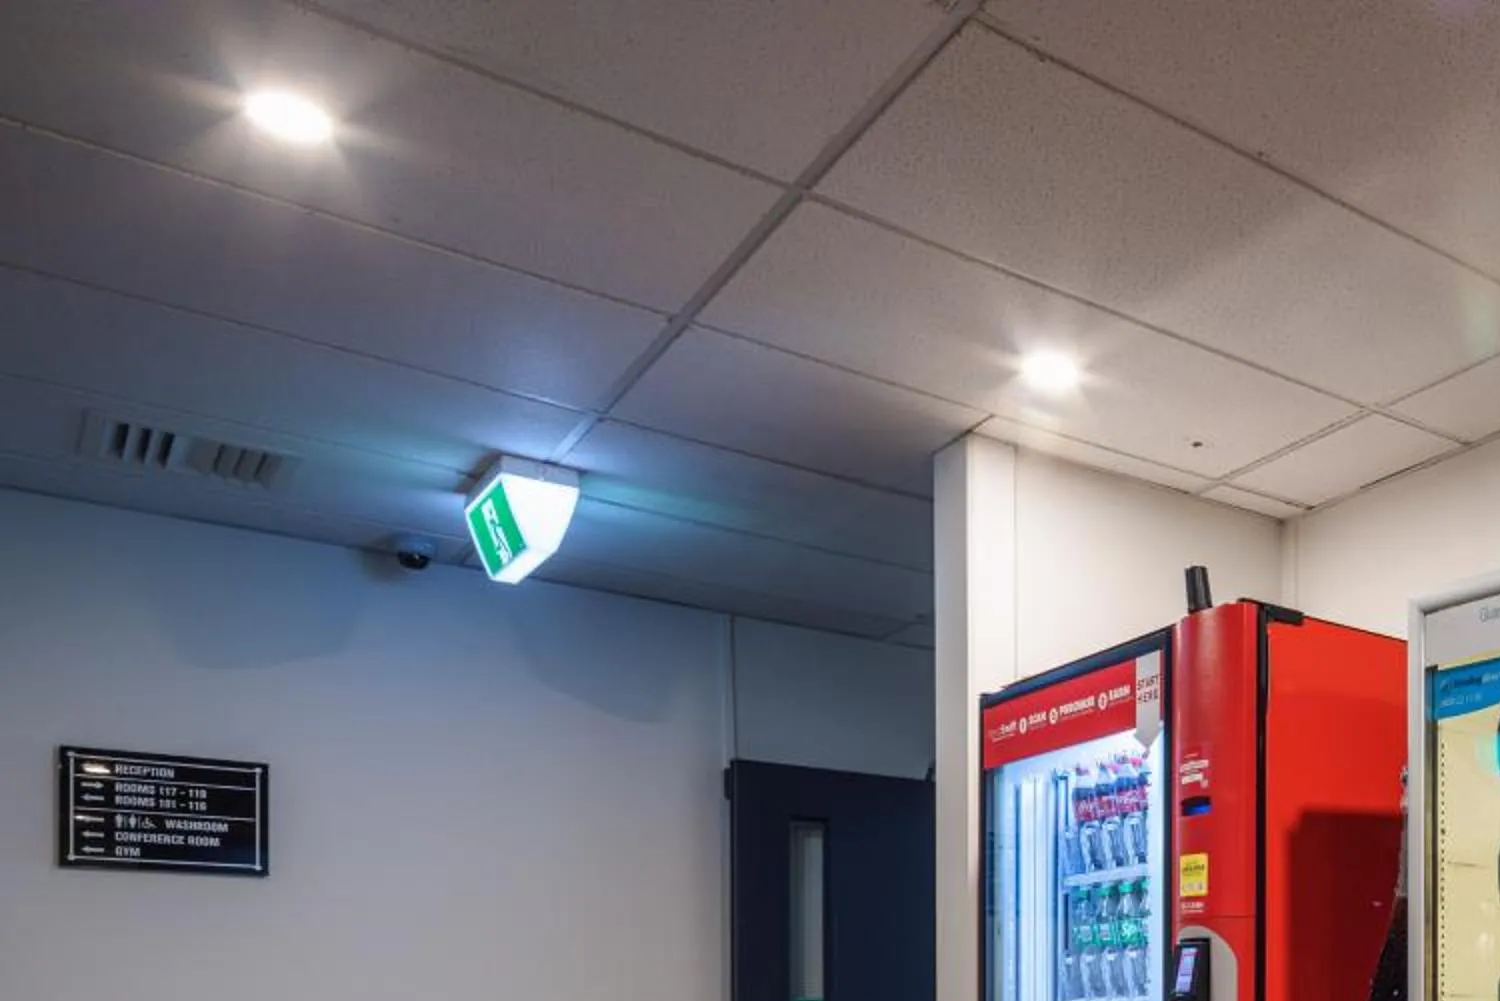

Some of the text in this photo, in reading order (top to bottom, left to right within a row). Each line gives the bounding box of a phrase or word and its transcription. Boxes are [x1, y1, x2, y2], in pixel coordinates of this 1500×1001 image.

[115, 764, 175, 778] RECEPTION
[115, 782, 156, 796] ROOMS
[115, 795, 156, 808] ROOMS
[164, 819, 229, 833] WASHROOM
[115, 831, 221, 847] CONFERENCE ROOM
